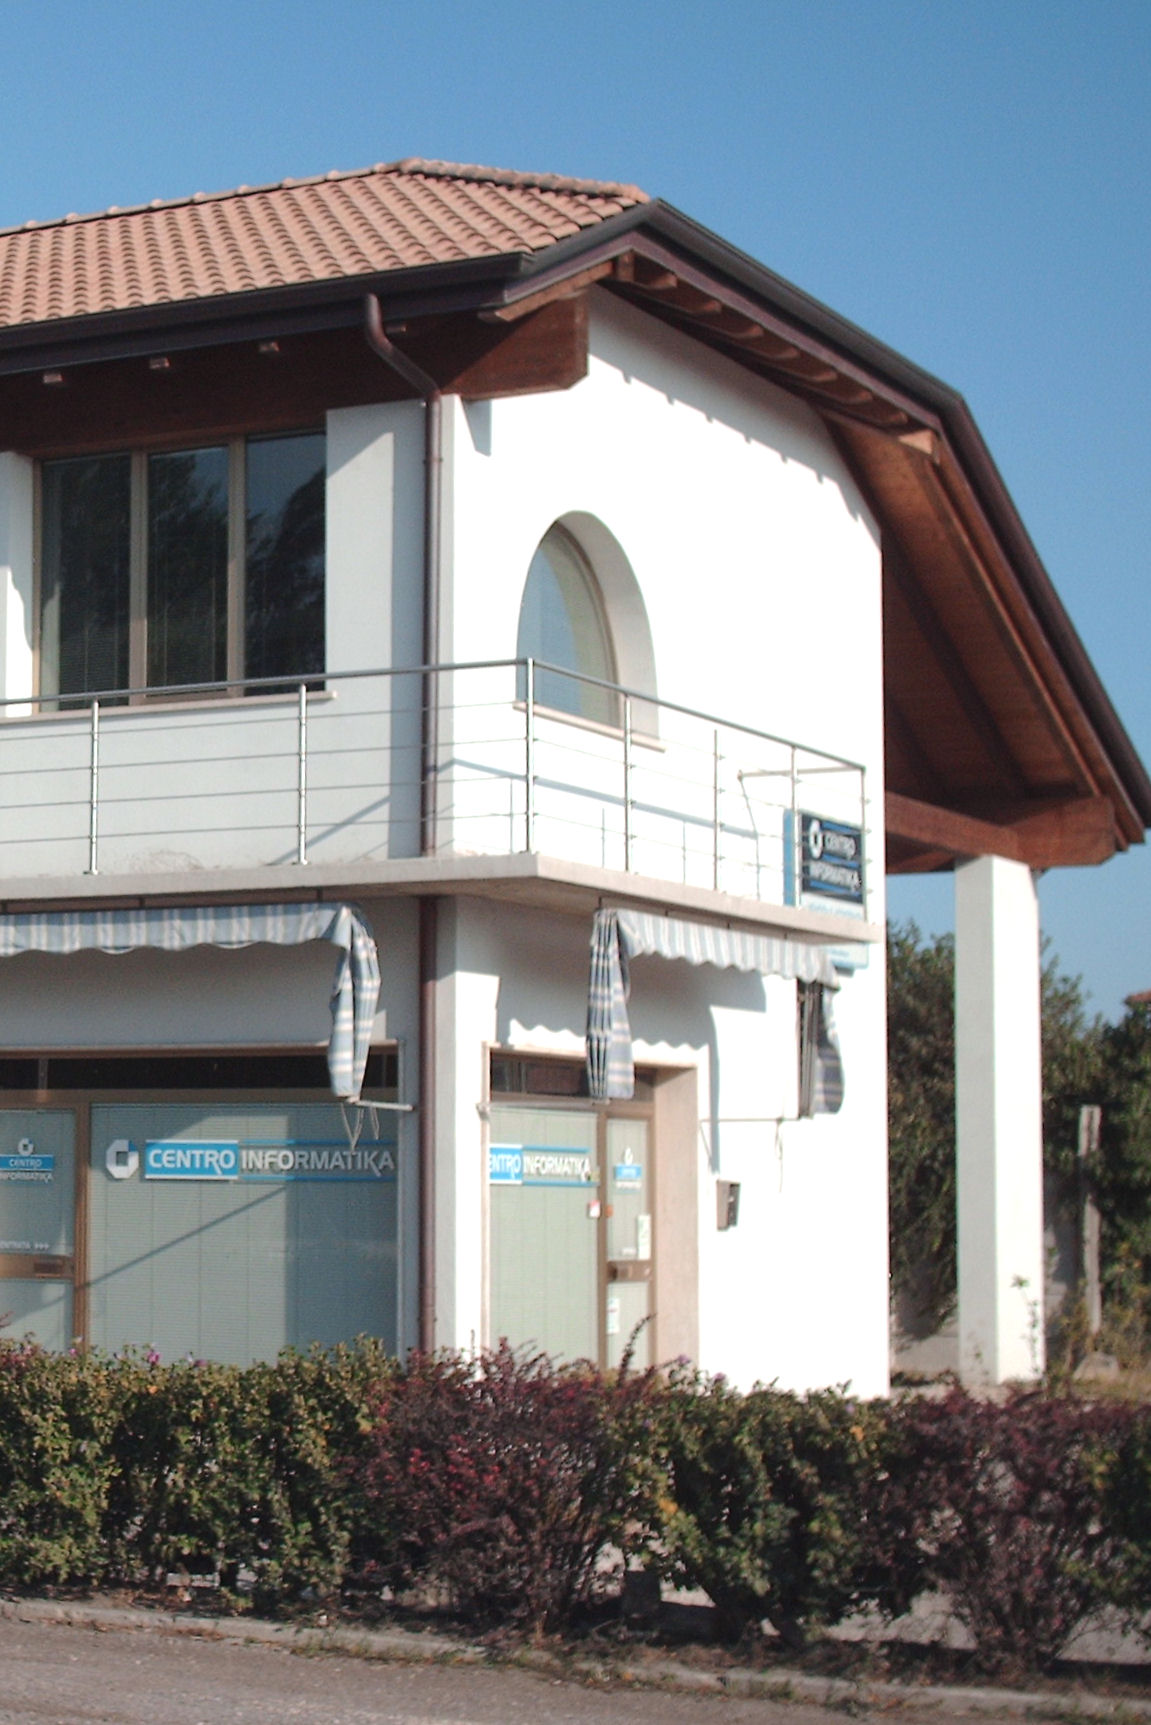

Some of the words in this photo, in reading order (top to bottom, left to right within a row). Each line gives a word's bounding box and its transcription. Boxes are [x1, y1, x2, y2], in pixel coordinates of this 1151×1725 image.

[9, 1158, 42, 1170] CENTRO
[148, 1149, 236, 1175] CENTRO
[242, 1149, 395, 1177] INFORMATIKA
[489, 1153, 522, 1179] ENTRO
[523, 1155, 591, 1183] INFORMATIKA
